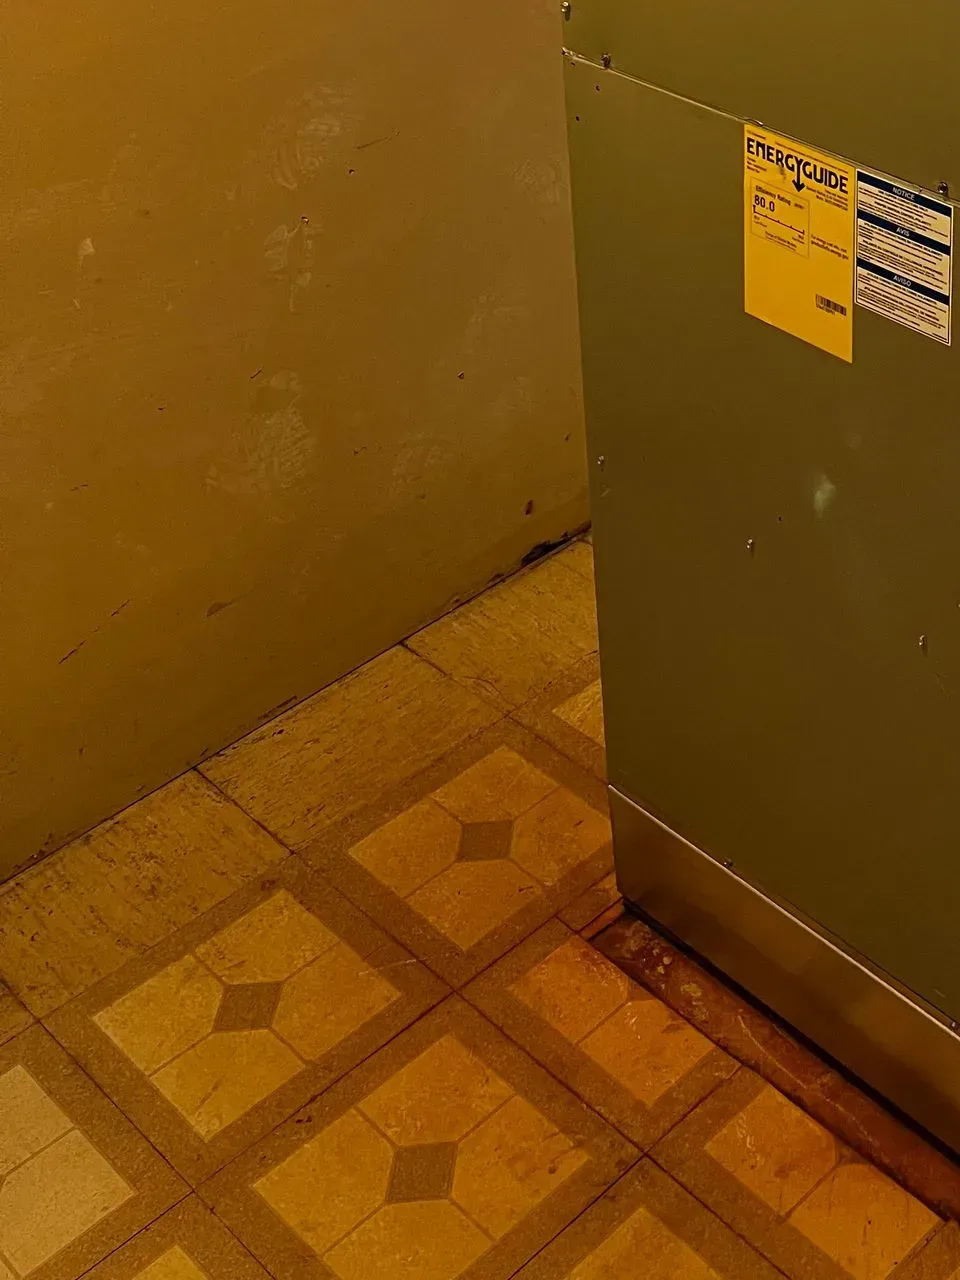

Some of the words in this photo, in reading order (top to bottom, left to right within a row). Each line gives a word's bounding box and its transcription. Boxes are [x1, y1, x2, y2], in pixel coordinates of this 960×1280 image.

[747, 137, 848, 195] ENERGYGUIDE
[892, 187, 915, 201] NOTICE
[754, 195, 775, 213] 80.0
[896, 227, 910, 238] AVIS
[893, 275, 912, 287] AVISO
